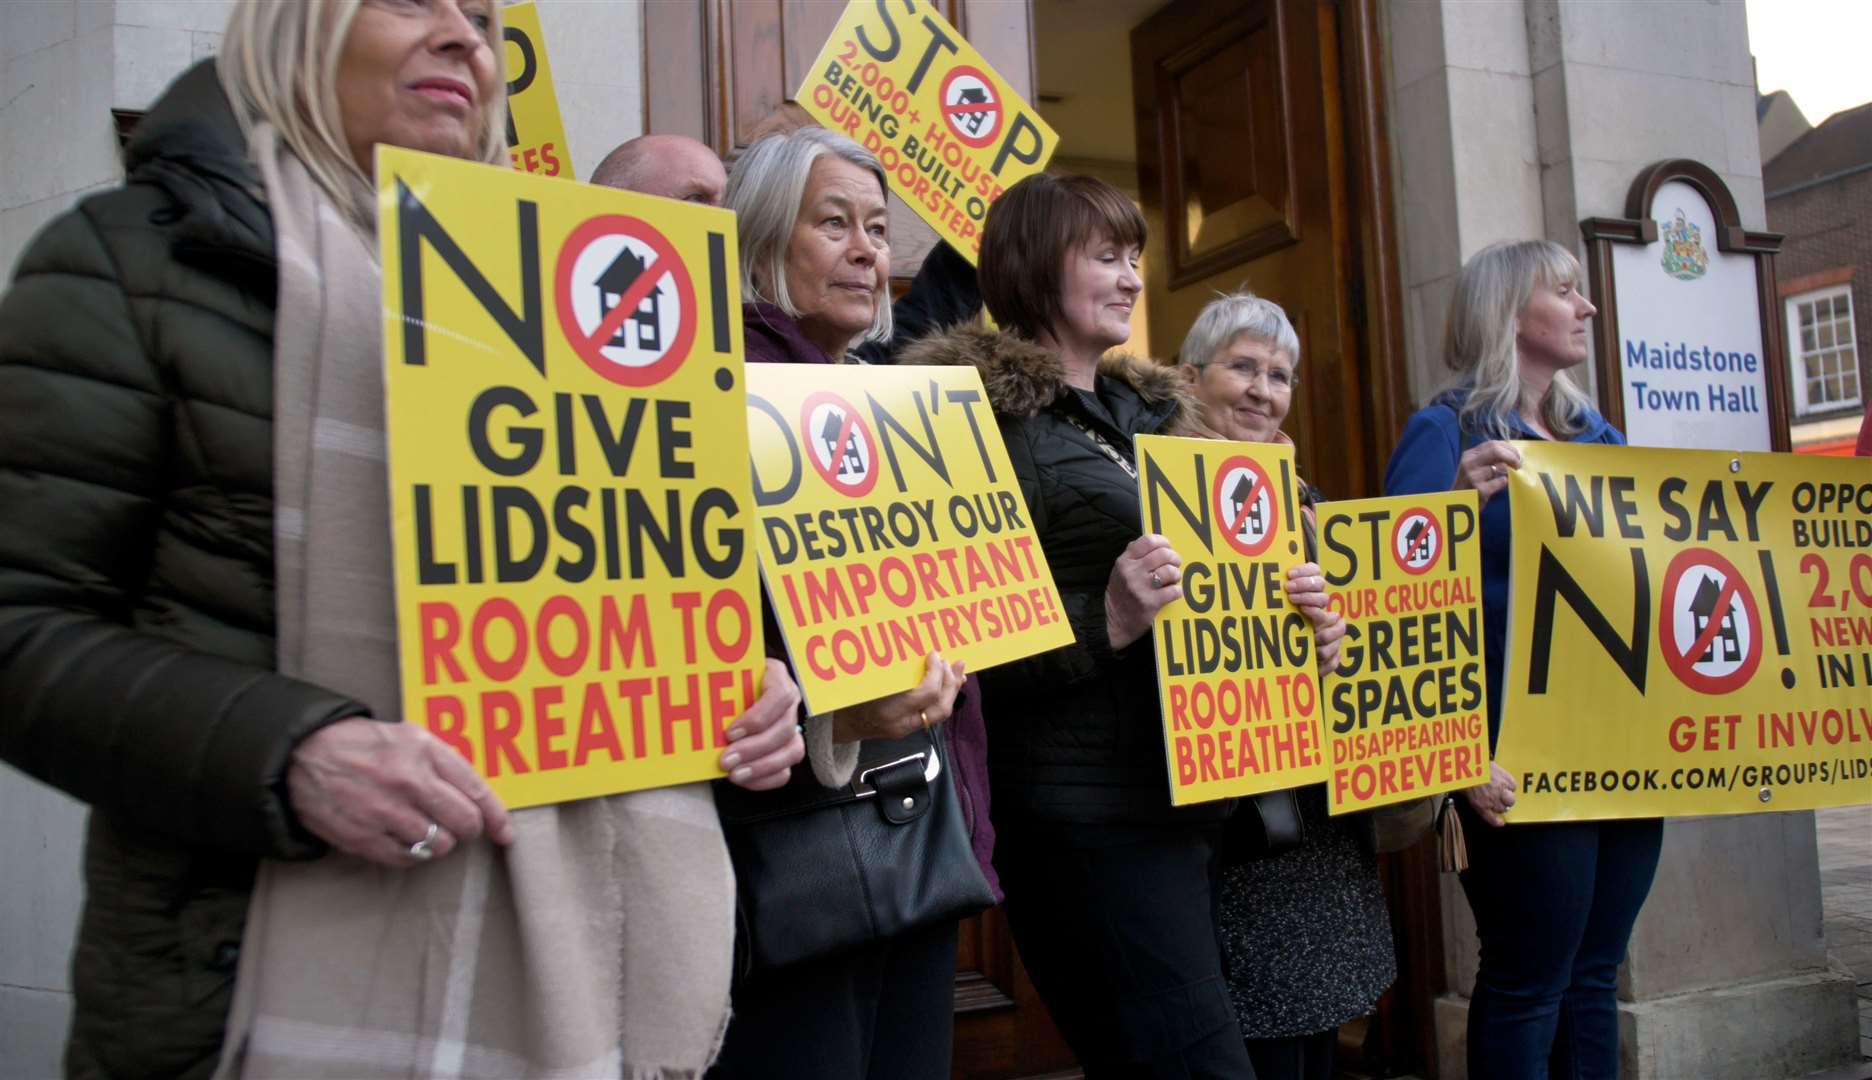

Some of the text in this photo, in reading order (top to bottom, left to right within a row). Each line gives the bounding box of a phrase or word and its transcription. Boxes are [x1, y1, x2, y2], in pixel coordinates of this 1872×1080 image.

[813, 83, 862, 139] OUR
[837, 40, 921, 125] 2,000+
[823, 60, 900, 139] BEING
[901, 134, 966, 200] BUILT
[1625, 339, 1757, 373] Maidstone
[1631, 381, 1759, 413] Town Hall
[467, 385, 696, 479] GIVE
[762, 490, 1027, 566] DESTROY OUR
[1538, 472, 1774, 542] WE SAY
[1792, 482, 1872, 514] OPPO
[412, 483, 745, 586] LIDSING
[1793, 519, 1872, 548] BUILD
[782, 536, 1040, 628] IMPORTANT
[1182, 561, 1284, 614] GIVE
[1327, 576, 1476, 620] OUR CRUCIAL
[417, 588, 752, 686] ROOM TO
[805, 586, 1060, 682] COUNTRYSIDE!
[1163, 612, 1309, 677] LIDSING
[1334, 607, 1479, 678] GREEN
[1169, 672, 1316, 732] ROOM TO
[1332, 662, 1482, 734] SPACES
[1817, 653, 1855, 689] IN
[1175, 719, 1322, 786] BREATHE!
[1332, 713, 1482, 765] DISAPPEARING
[1669, 715, 1742, 753] GET
[1335, 743, 1483, 805] FOREVER!
[1523, 758, 1872, 794] FACEBOOK.COM/GROUPS/LID
